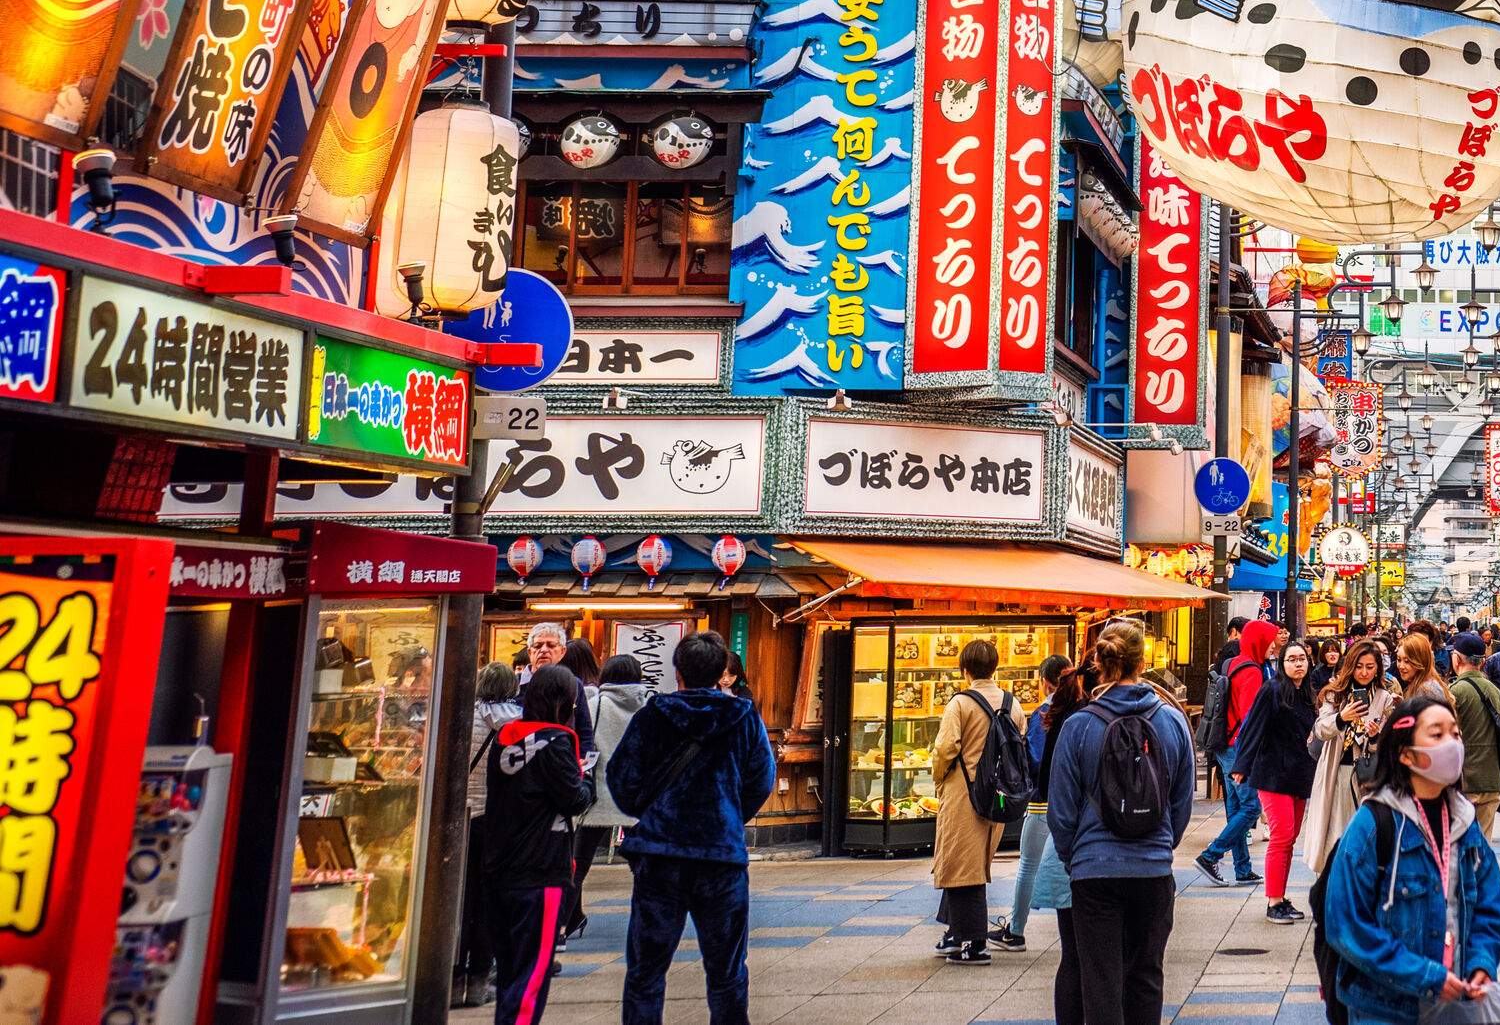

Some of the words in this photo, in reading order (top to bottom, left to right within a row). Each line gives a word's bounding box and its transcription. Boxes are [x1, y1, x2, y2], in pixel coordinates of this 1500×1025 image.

[1131, 64, 1328, 183] づぼらや
[932, 137, 981, 348] てっちり
[1006, 137, 1047, 349] てっちり
[84, 300, 290, 427] 24時間営業
[323, 372, 401, 429] 日本一の串かつ
[403, 372, 464, 462] 横綱
[1351, 392, 1375, 455] 串かつ
[818, 448, 1033, 497] づぼらや本店
[346, 560, 405, 584] 横綱
[411, 569, 461, 583] 通天閣店
